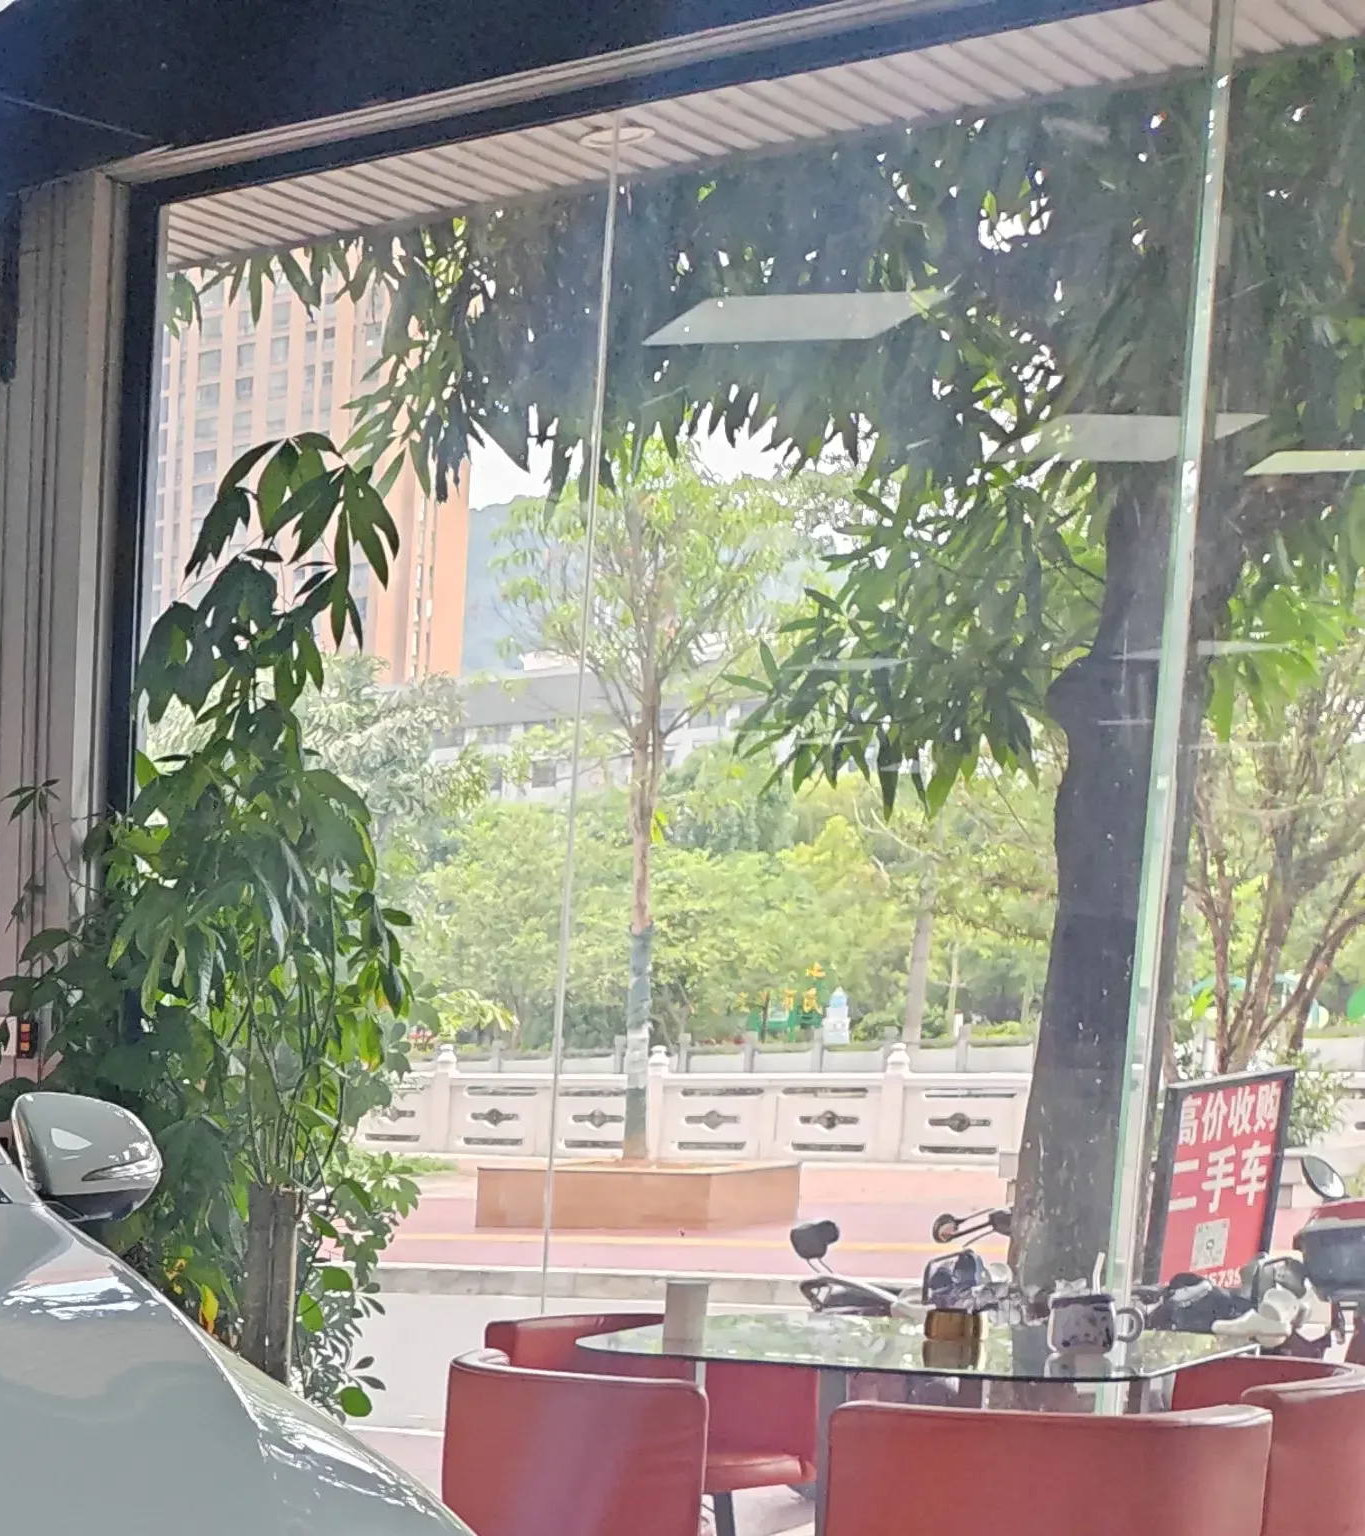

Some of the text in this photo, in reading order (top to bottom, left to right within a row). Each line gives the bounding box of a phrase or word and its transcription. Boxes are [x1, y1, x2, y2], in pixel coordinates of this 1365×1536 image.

[1178, 1081, 1282, 1146] 高价收购
[1168, 1140, 1272, 1213] 二手车
